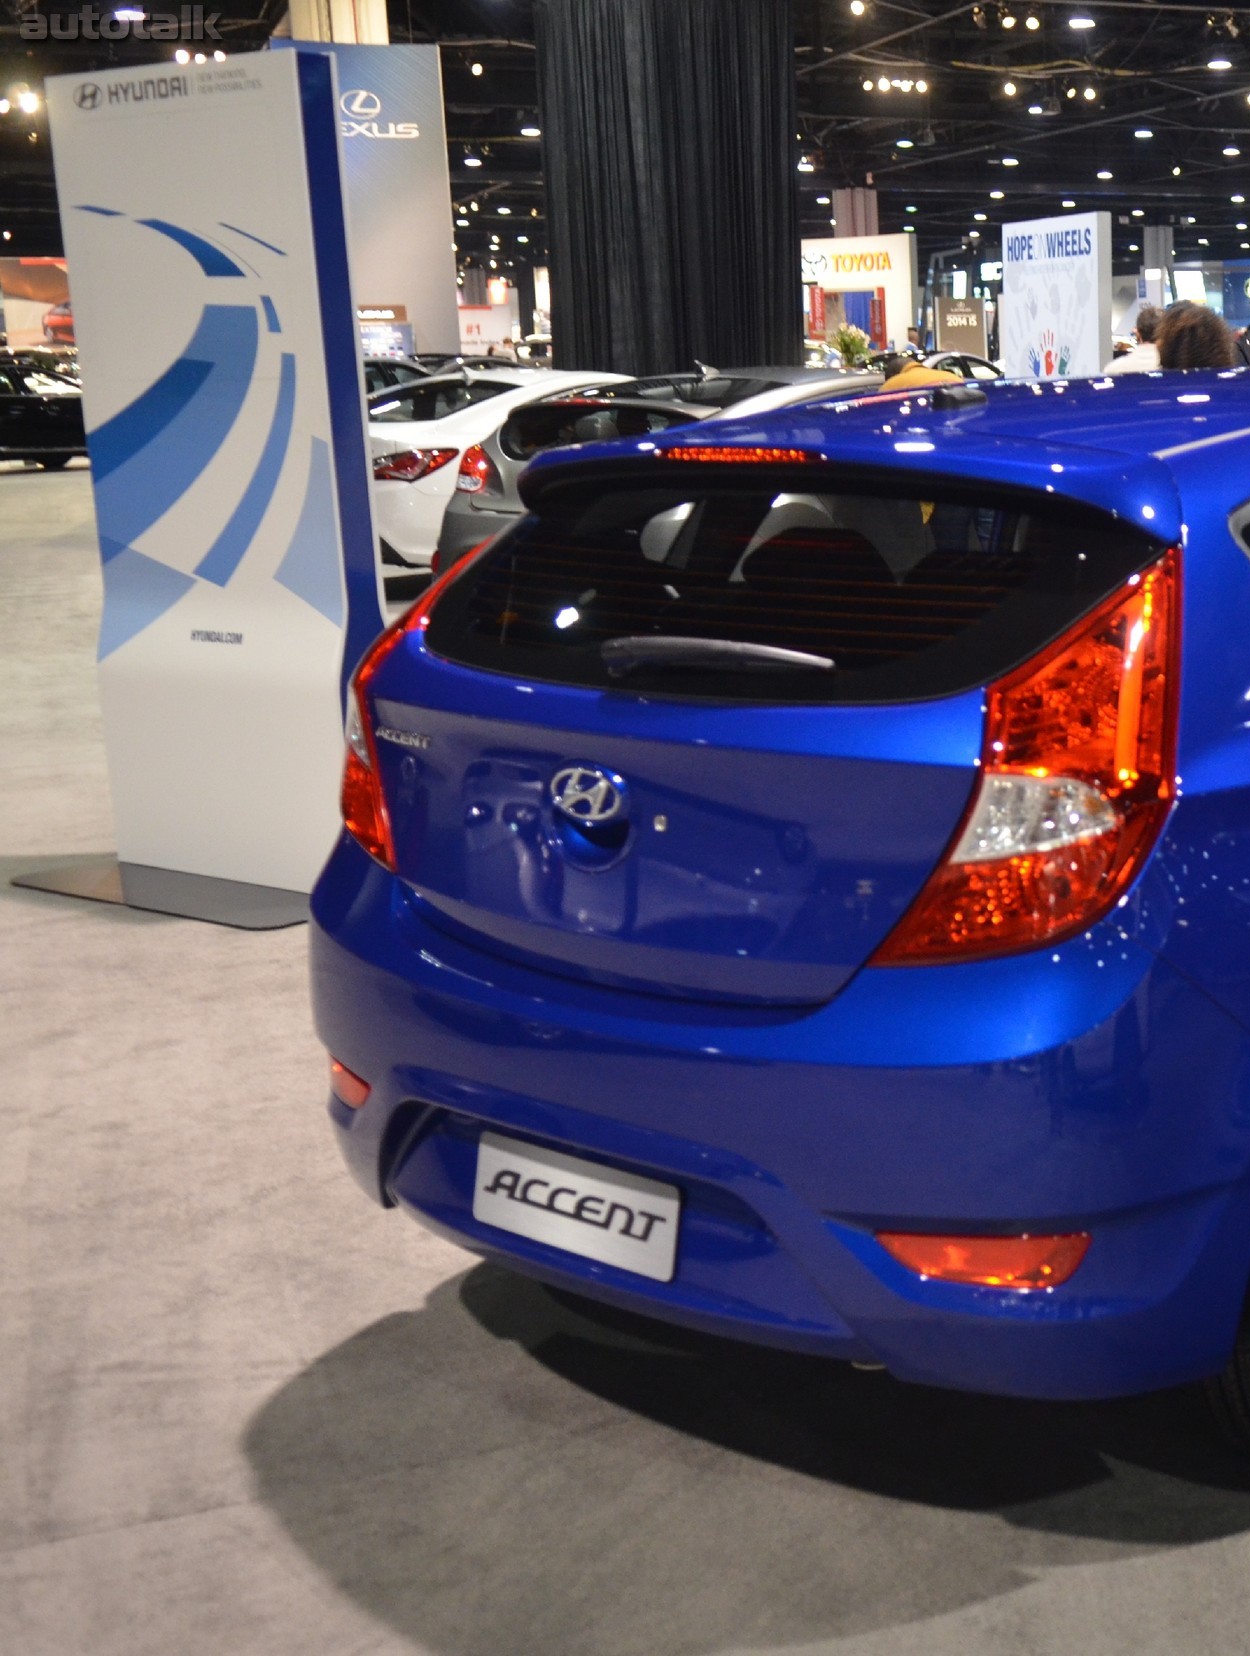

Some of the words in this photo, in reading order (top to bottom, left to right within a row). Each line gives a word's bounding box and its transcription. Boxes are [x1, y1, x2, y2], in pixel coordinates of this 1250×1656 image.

[108, 76, 188, 104] HYUNDAI
[341, 121, 419, 138] XUS
[1007, 235, 1033, 262] HOPE
[1046, 228, 1092, 259] WHEELS
[831, 251, 892, 273] TOYOTA
[190, 629, 243, 645] HYUNDAI.COM
[375, 726, 431, 750] ACCENT
[483, 1169, 667, 1243] ACCENT
